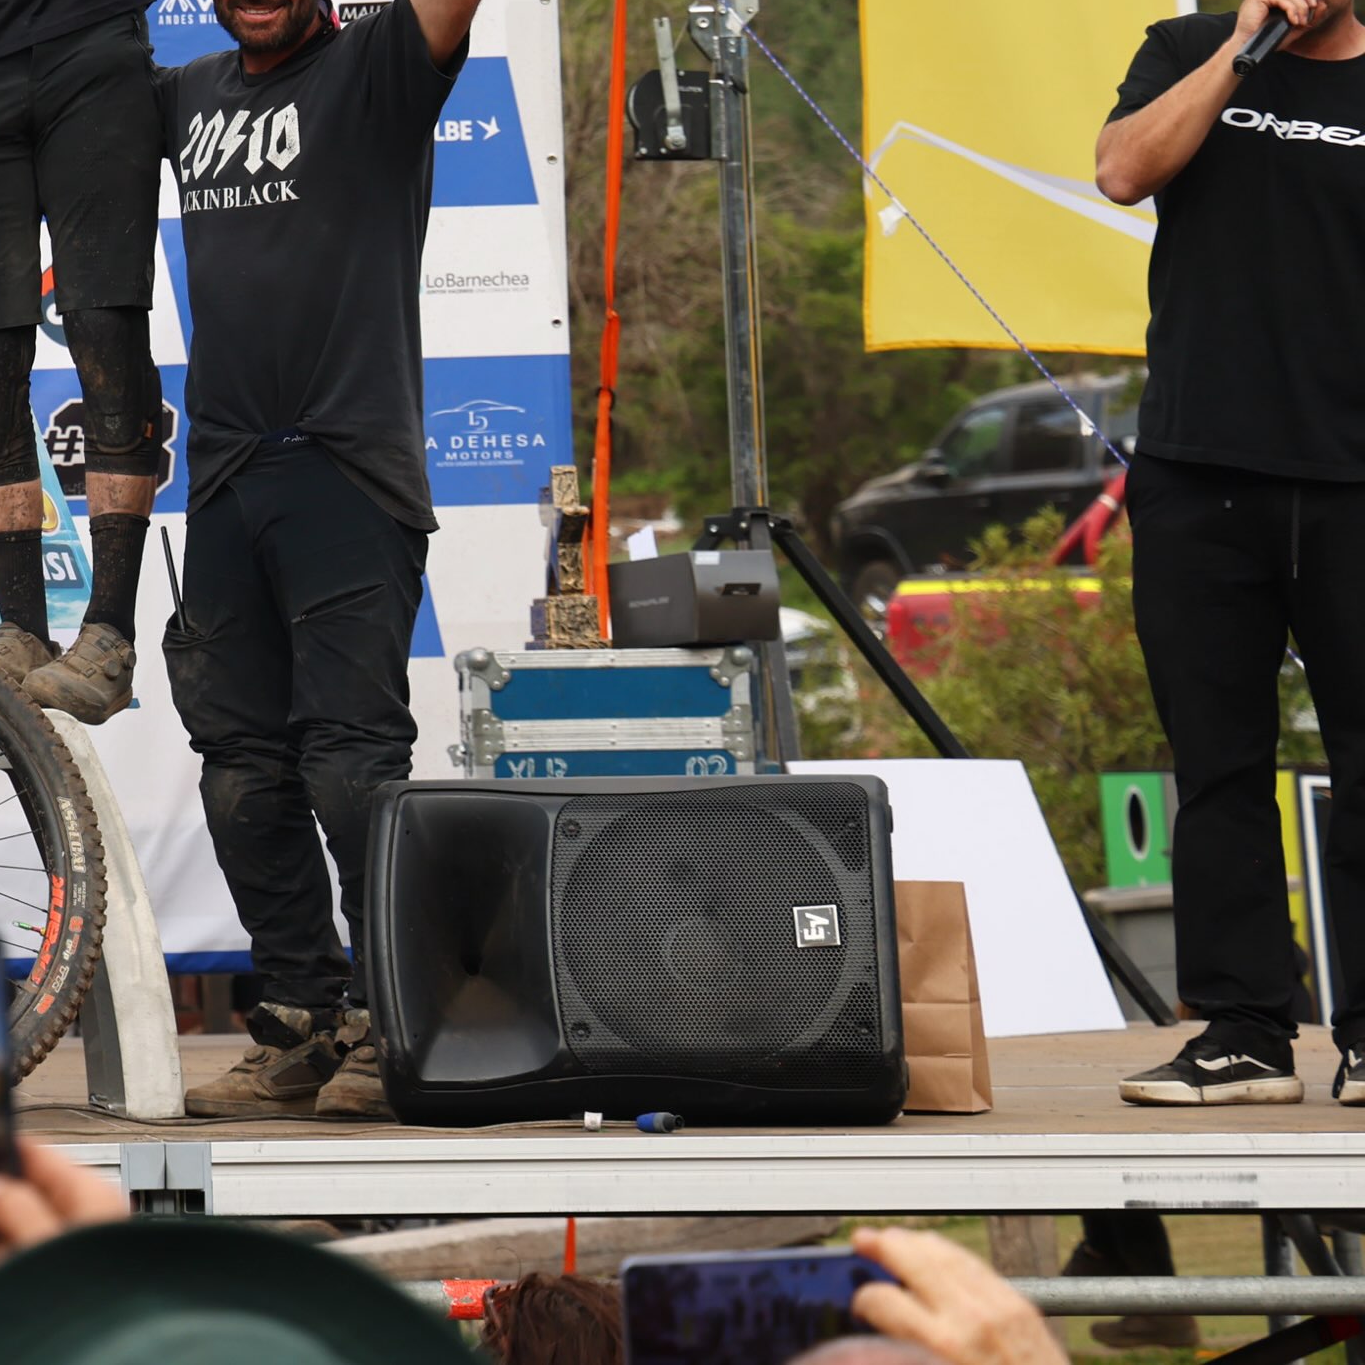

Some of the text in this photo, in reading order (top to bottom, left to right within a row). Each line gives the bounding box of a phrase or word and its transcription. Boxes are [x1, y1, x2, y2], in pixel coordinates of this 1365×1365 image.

[158, 14, 194, 25] ANDES
[207, 180, 300, 209] IN BLACK
[450, 434, 546, 449] DEHESA
[445, 451, 514, 460] MOTORS
[44, 551, 77, 581] SI
